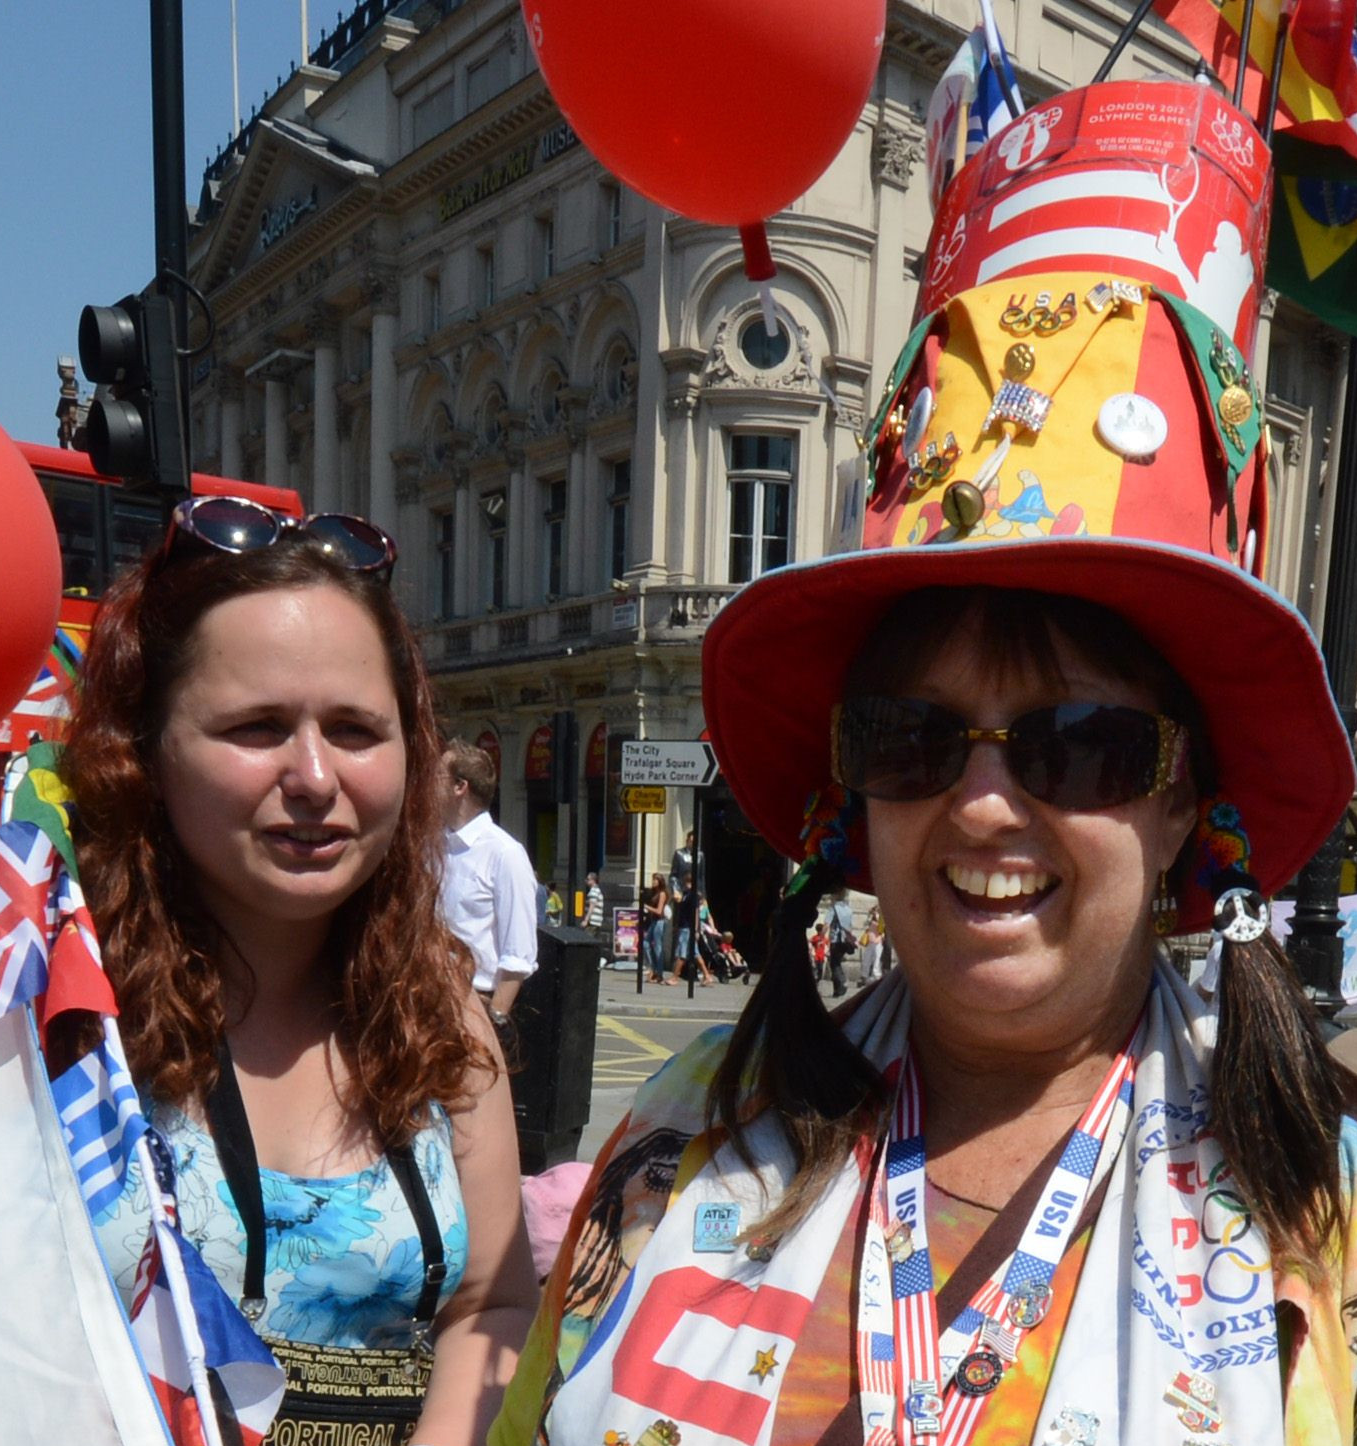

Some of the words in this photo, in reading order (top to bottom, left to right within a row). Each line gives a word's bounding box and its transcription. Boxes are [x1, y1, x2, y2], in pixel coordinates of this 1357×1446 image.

[1100, 103, 1155, 113] LONDON
[1160, 104, 1185, 114] 2012
[1089, 112, 1143, 124] OLYMPIC
[1149, 113, 1192, 126] GAMES
[1009, 291, 1076, 308] USA
[625, 745, 640, 754] The
[643, 745, 660, 756] City
[625, 758, 662, 769] Trafalgar
[666, 758, 696, 769] Square
[624, 772, 645, 782] Hyde
[648, 771, 667, 780] Park
[670, 771, 699, 781] Corner
[703, 1208, 733, 1219] AT&T
[1034, 1188, 1077, 1240] USA
[272, 1347, 313, 1361] PORTUGAL
[316, 1354, 359, 1365] PORTUGAL
[361, 1357, 397, 1366] PORTUGAL
[306, 1382, 363, 1397] PORTUGAL
[366, 1385, 414, 1397] PORTUGAL
